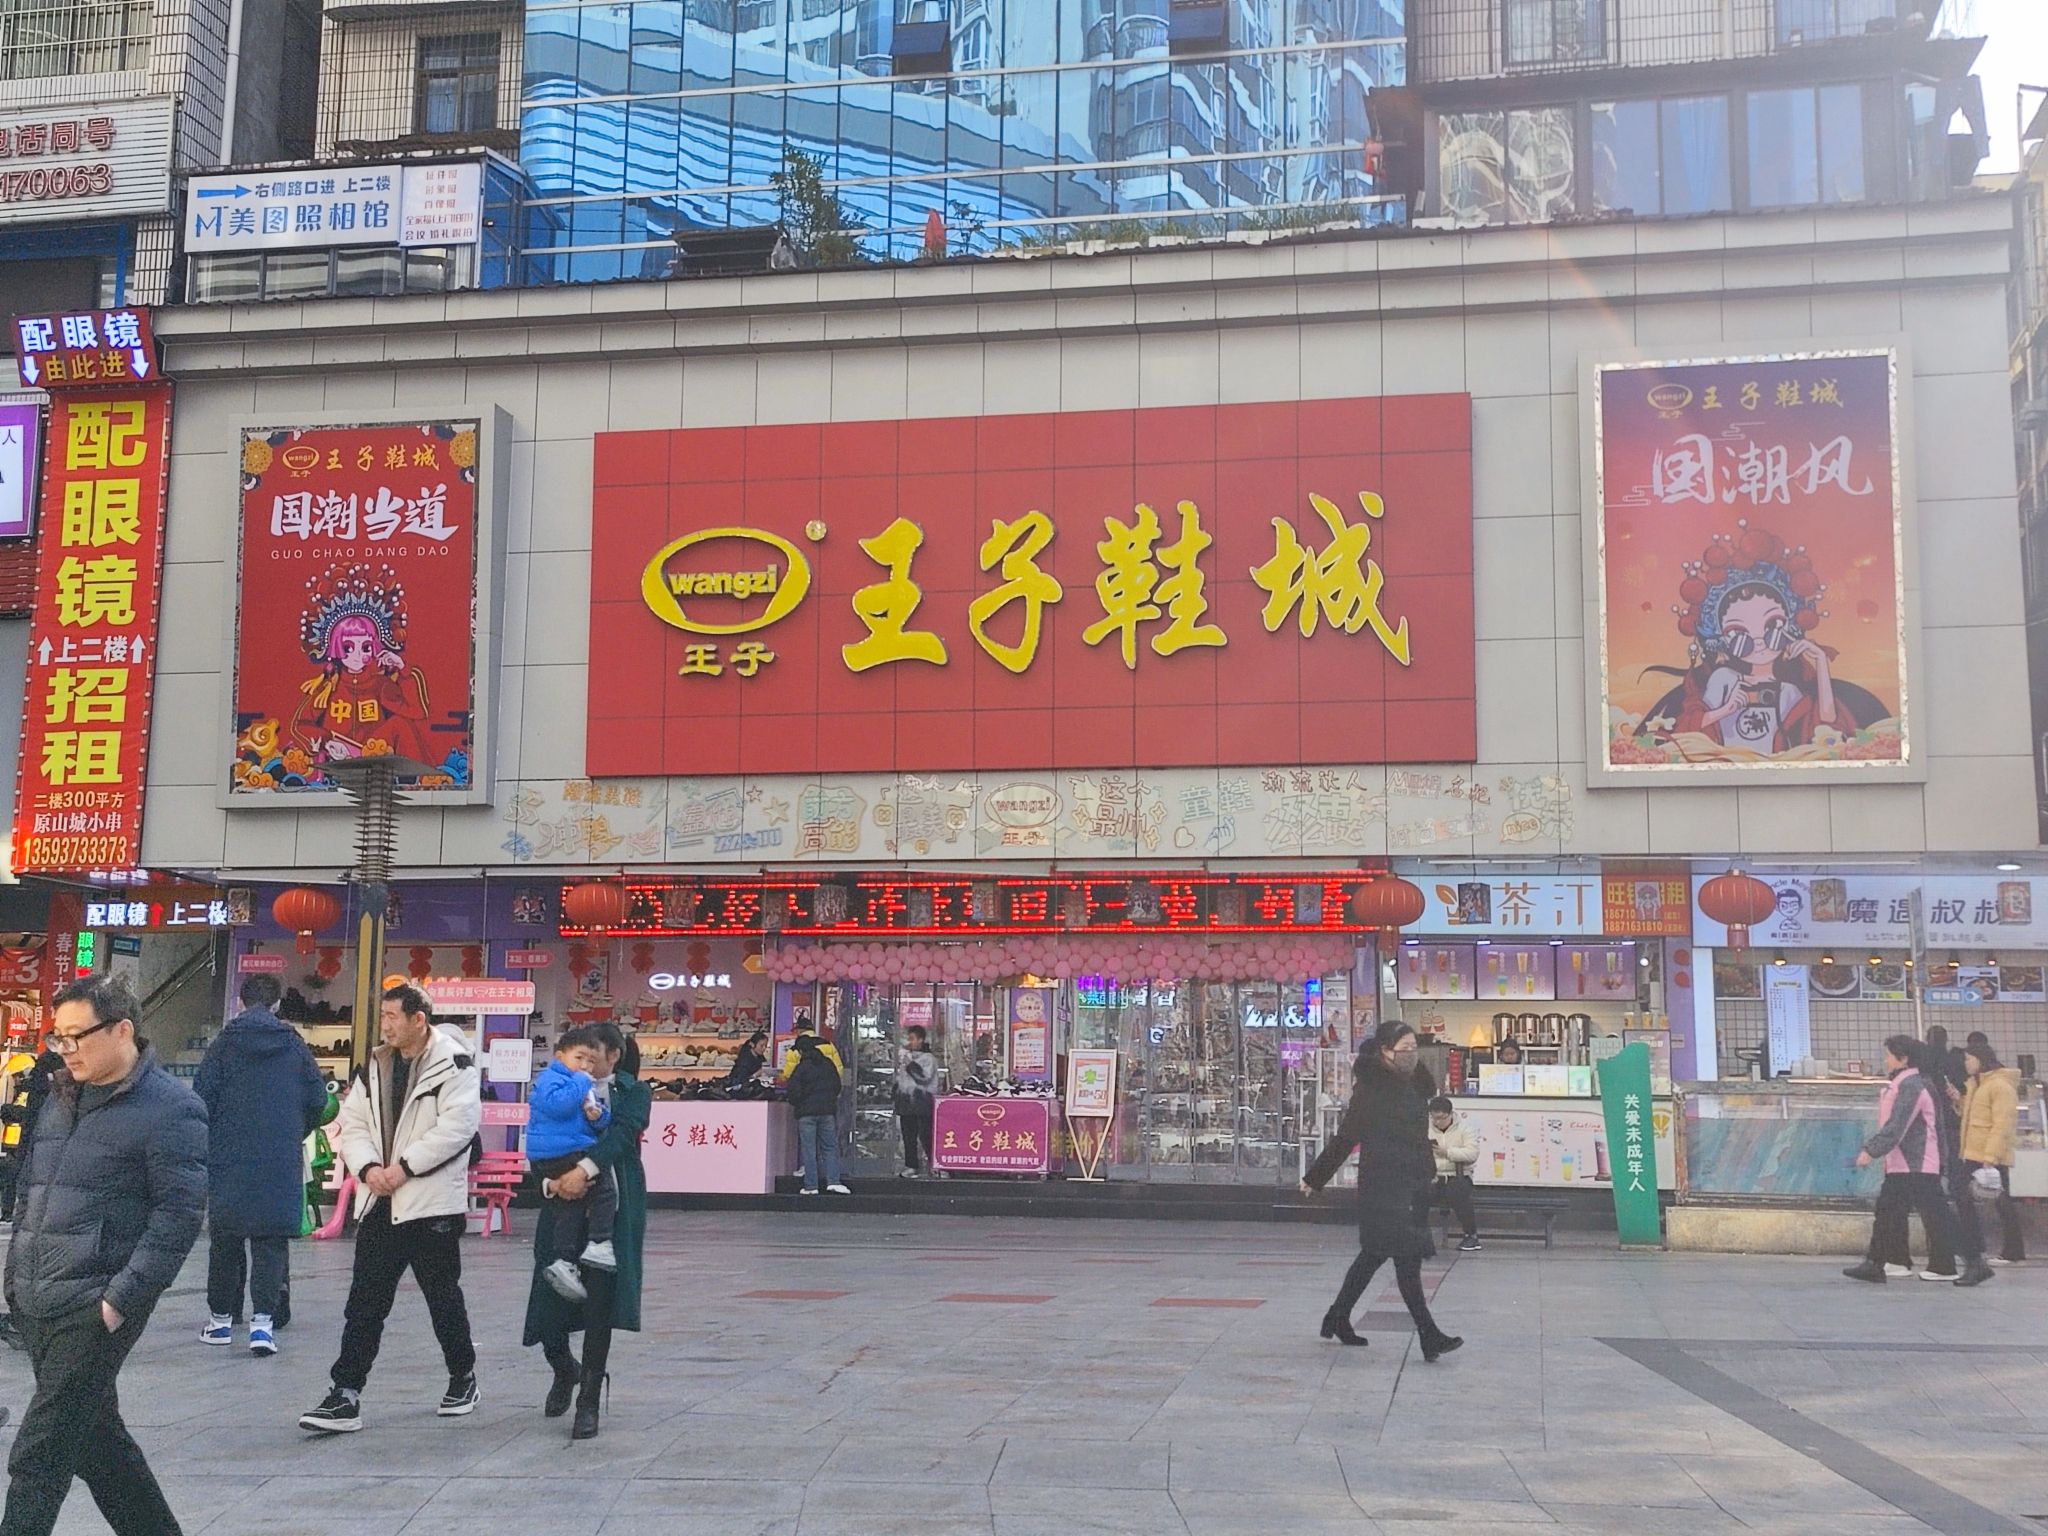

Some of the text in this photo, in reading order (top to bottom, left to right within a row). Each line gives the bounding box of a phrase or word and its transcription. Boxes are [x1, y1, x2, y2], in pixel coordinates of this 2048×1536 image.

[256, 175, 391, 198] 右侧路口进 上二楼
[229, 200, 390, 236] 美图照相馆
[18, 311, 142, 352] 配眼镜
[46, 351, 126, 381] 由此进
[1702, 378, 1844, 411] 王子鞋城
[326, 443, 440, 471] 王子鞋城
[1652, 433, 1874, 505] 国潮风
[54, 400, 148, 626] 配眼镜
[271, 483, 459, 540] 国潮当道
[271, 546, 449, 559] GUO CHAO DANG DAO
[668, 564, 777, 599] wangzi
[841, 491, 1412, 674] 王子鞋城
[54, 636, 129, 663] 上二楼
[678, 642, 776, 677] 王子
[41, 667, 130, 785] 招租
[330, 699, 379, 723] 中国
[1099, 775, 1152, 808] 这个
[1261, 770, 1368, 793] 潮流达人
[34, 791, 125, 809] 二楼300平方
[1179, 776, 1255, 823] 童鞋
[33, 812, 122, 833] 原山城小串
[1090, 803, 1148, 837] 最帅
[24, 836, 127, 864] 13593733373
[1491, 881, 1594, 926] 茶汀
[1607, 882, 1686, 905] 旺租
[86, 903, 148, 926] 配眼镜
[167, 901, 228, 926] 上二楼
[77, 932, 94, 967] 眼镜
[943, 1130, 1038, 1154] 王子鞋城
[1624, 1094, 1645, 1192] 关爱未成年人
